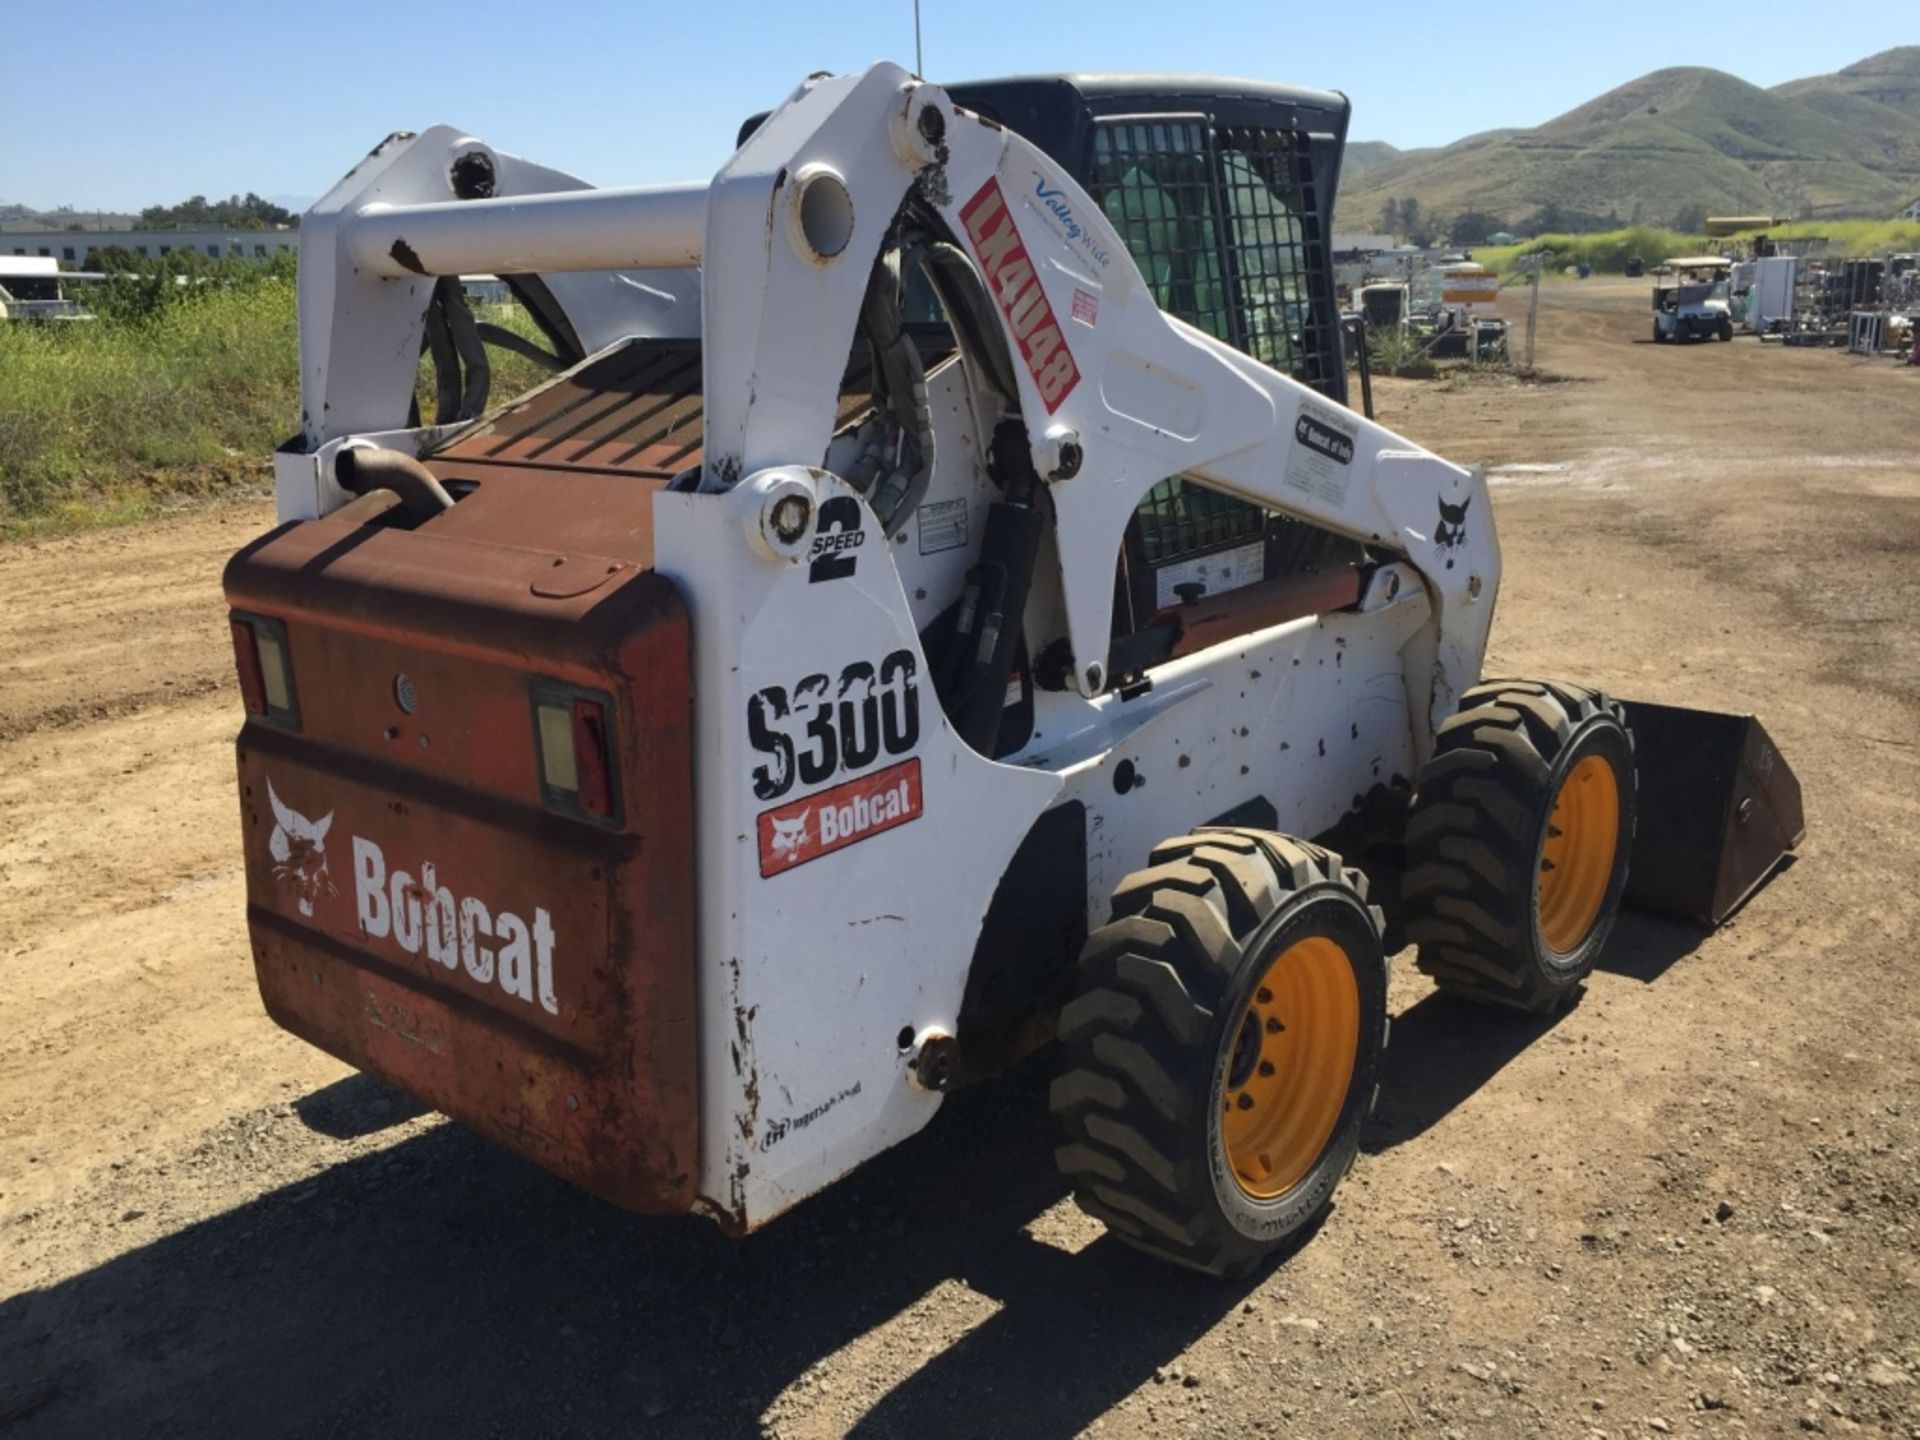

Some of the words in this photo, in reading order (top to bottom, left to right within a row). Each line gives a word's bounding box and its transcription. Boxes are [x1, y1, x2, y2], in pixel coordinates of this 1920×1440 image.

[966, 189, 1075, 403] LX4U48
[808, 496, 861, 584] 2
[811, 530, 865, 554] SPEED
[748, 649, 920, 801] S300
[819, 779, 911, 846] Bobcat
[352, 835, 559, 1016] Bobcat
